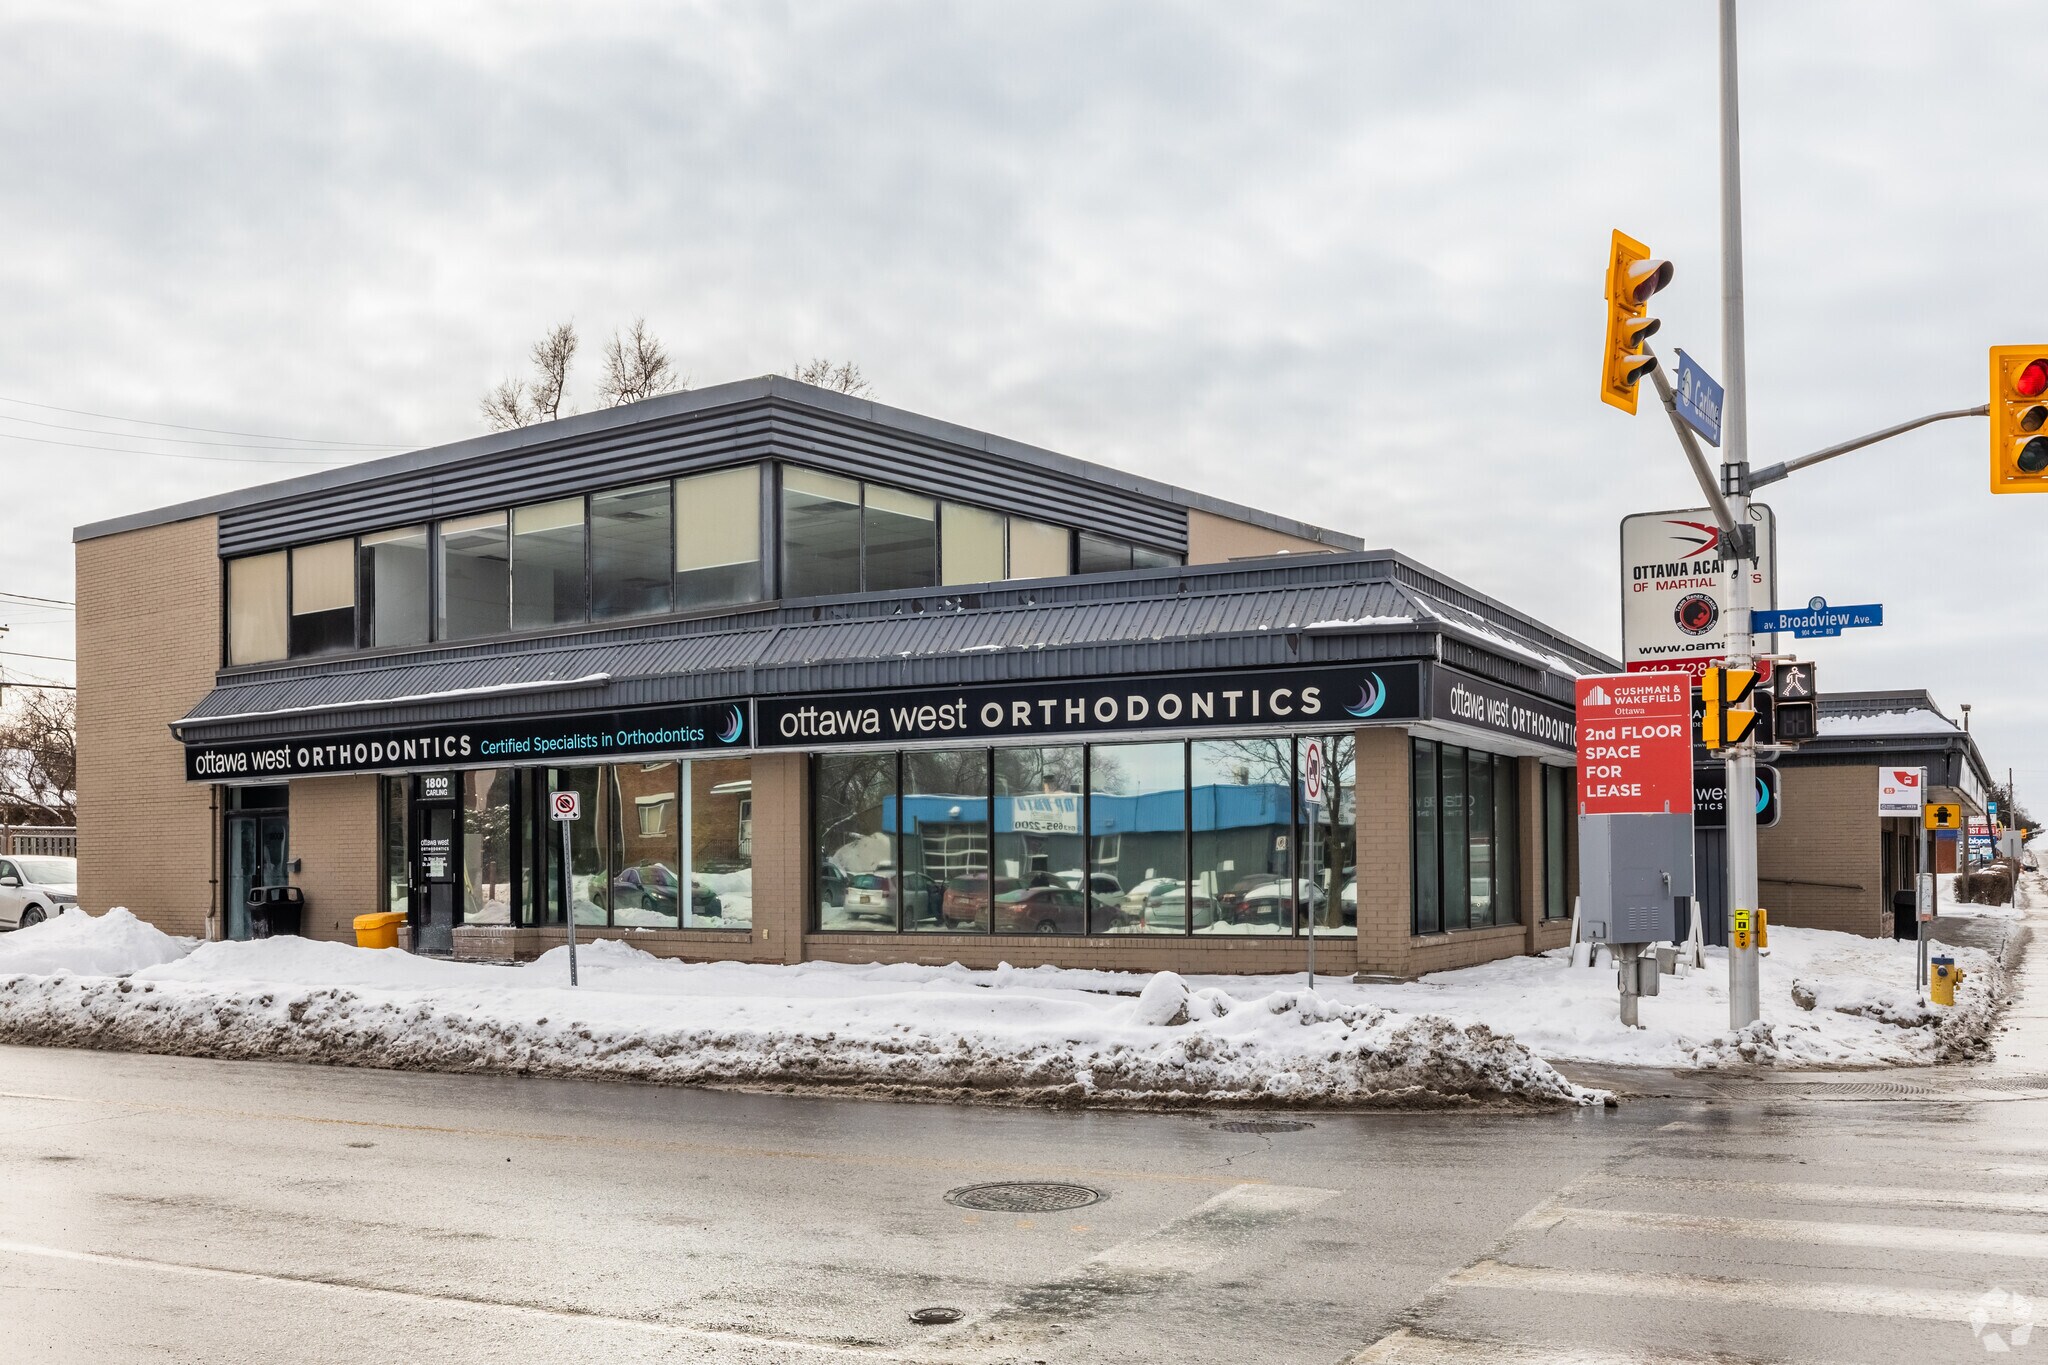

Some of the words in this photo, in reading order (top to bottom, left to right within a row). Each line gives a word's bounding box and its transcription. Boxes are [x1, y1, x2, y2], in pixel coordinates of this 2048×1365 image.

[1695, 380, 1719, 440] Carling
[1633, 562, 1688, 580] OTTAWA
[1693, 556, 1760, 575] ACAY
[1633, 582, 1649, 593] OF
[1656, 577, 1716, 591] MARTIAL
[1675, 599, 1687, 612] Team
[1763, 622, 1776, 630] av.
[1779, 611, 1850, 629] Broadview
[1853, 615, 1872, 625] Ave.
[1614, 685, 1670, 696] CUSHMAN
[1673, 685, 1681, 693] &
[1614, 694, 1681, 705] WAKEFIELD
[779, 705, 881, 738] ottawa
[890, 698, 967, 732] west
[980, 686, 1322, 728] ORTHODONTICS
[1450, 682, 1485, 722] ottawa
[1486, 698, 1509, 728] west
[1511, 705, 1578, 748] ORTHODONTIC
[1615, 707, 1645, 716] Ottawa
[1585, 726, 1616, 741] 2nd
[1621, 724, 1682, 740] FLOOR
[195, 750, 248, 775] ottawa
[251, 744, 291, 770] west
[297, 735, 472, 768] ORTHODONTICS
[480, 737, 531, 755] Certified
[533, 733, 598, 754] Specialists
[601, 732, 613, 747] in
[616, 726, 705, 746] Orthodontics
[1585, 745, 1641, 759] SPACE
[1586, 765, 1622, 779] FOR
[425, 777, 448, 788] 1800
[425, 788, 448, 797] CARLING
[1586, 783, 1642, 798] LEASE
